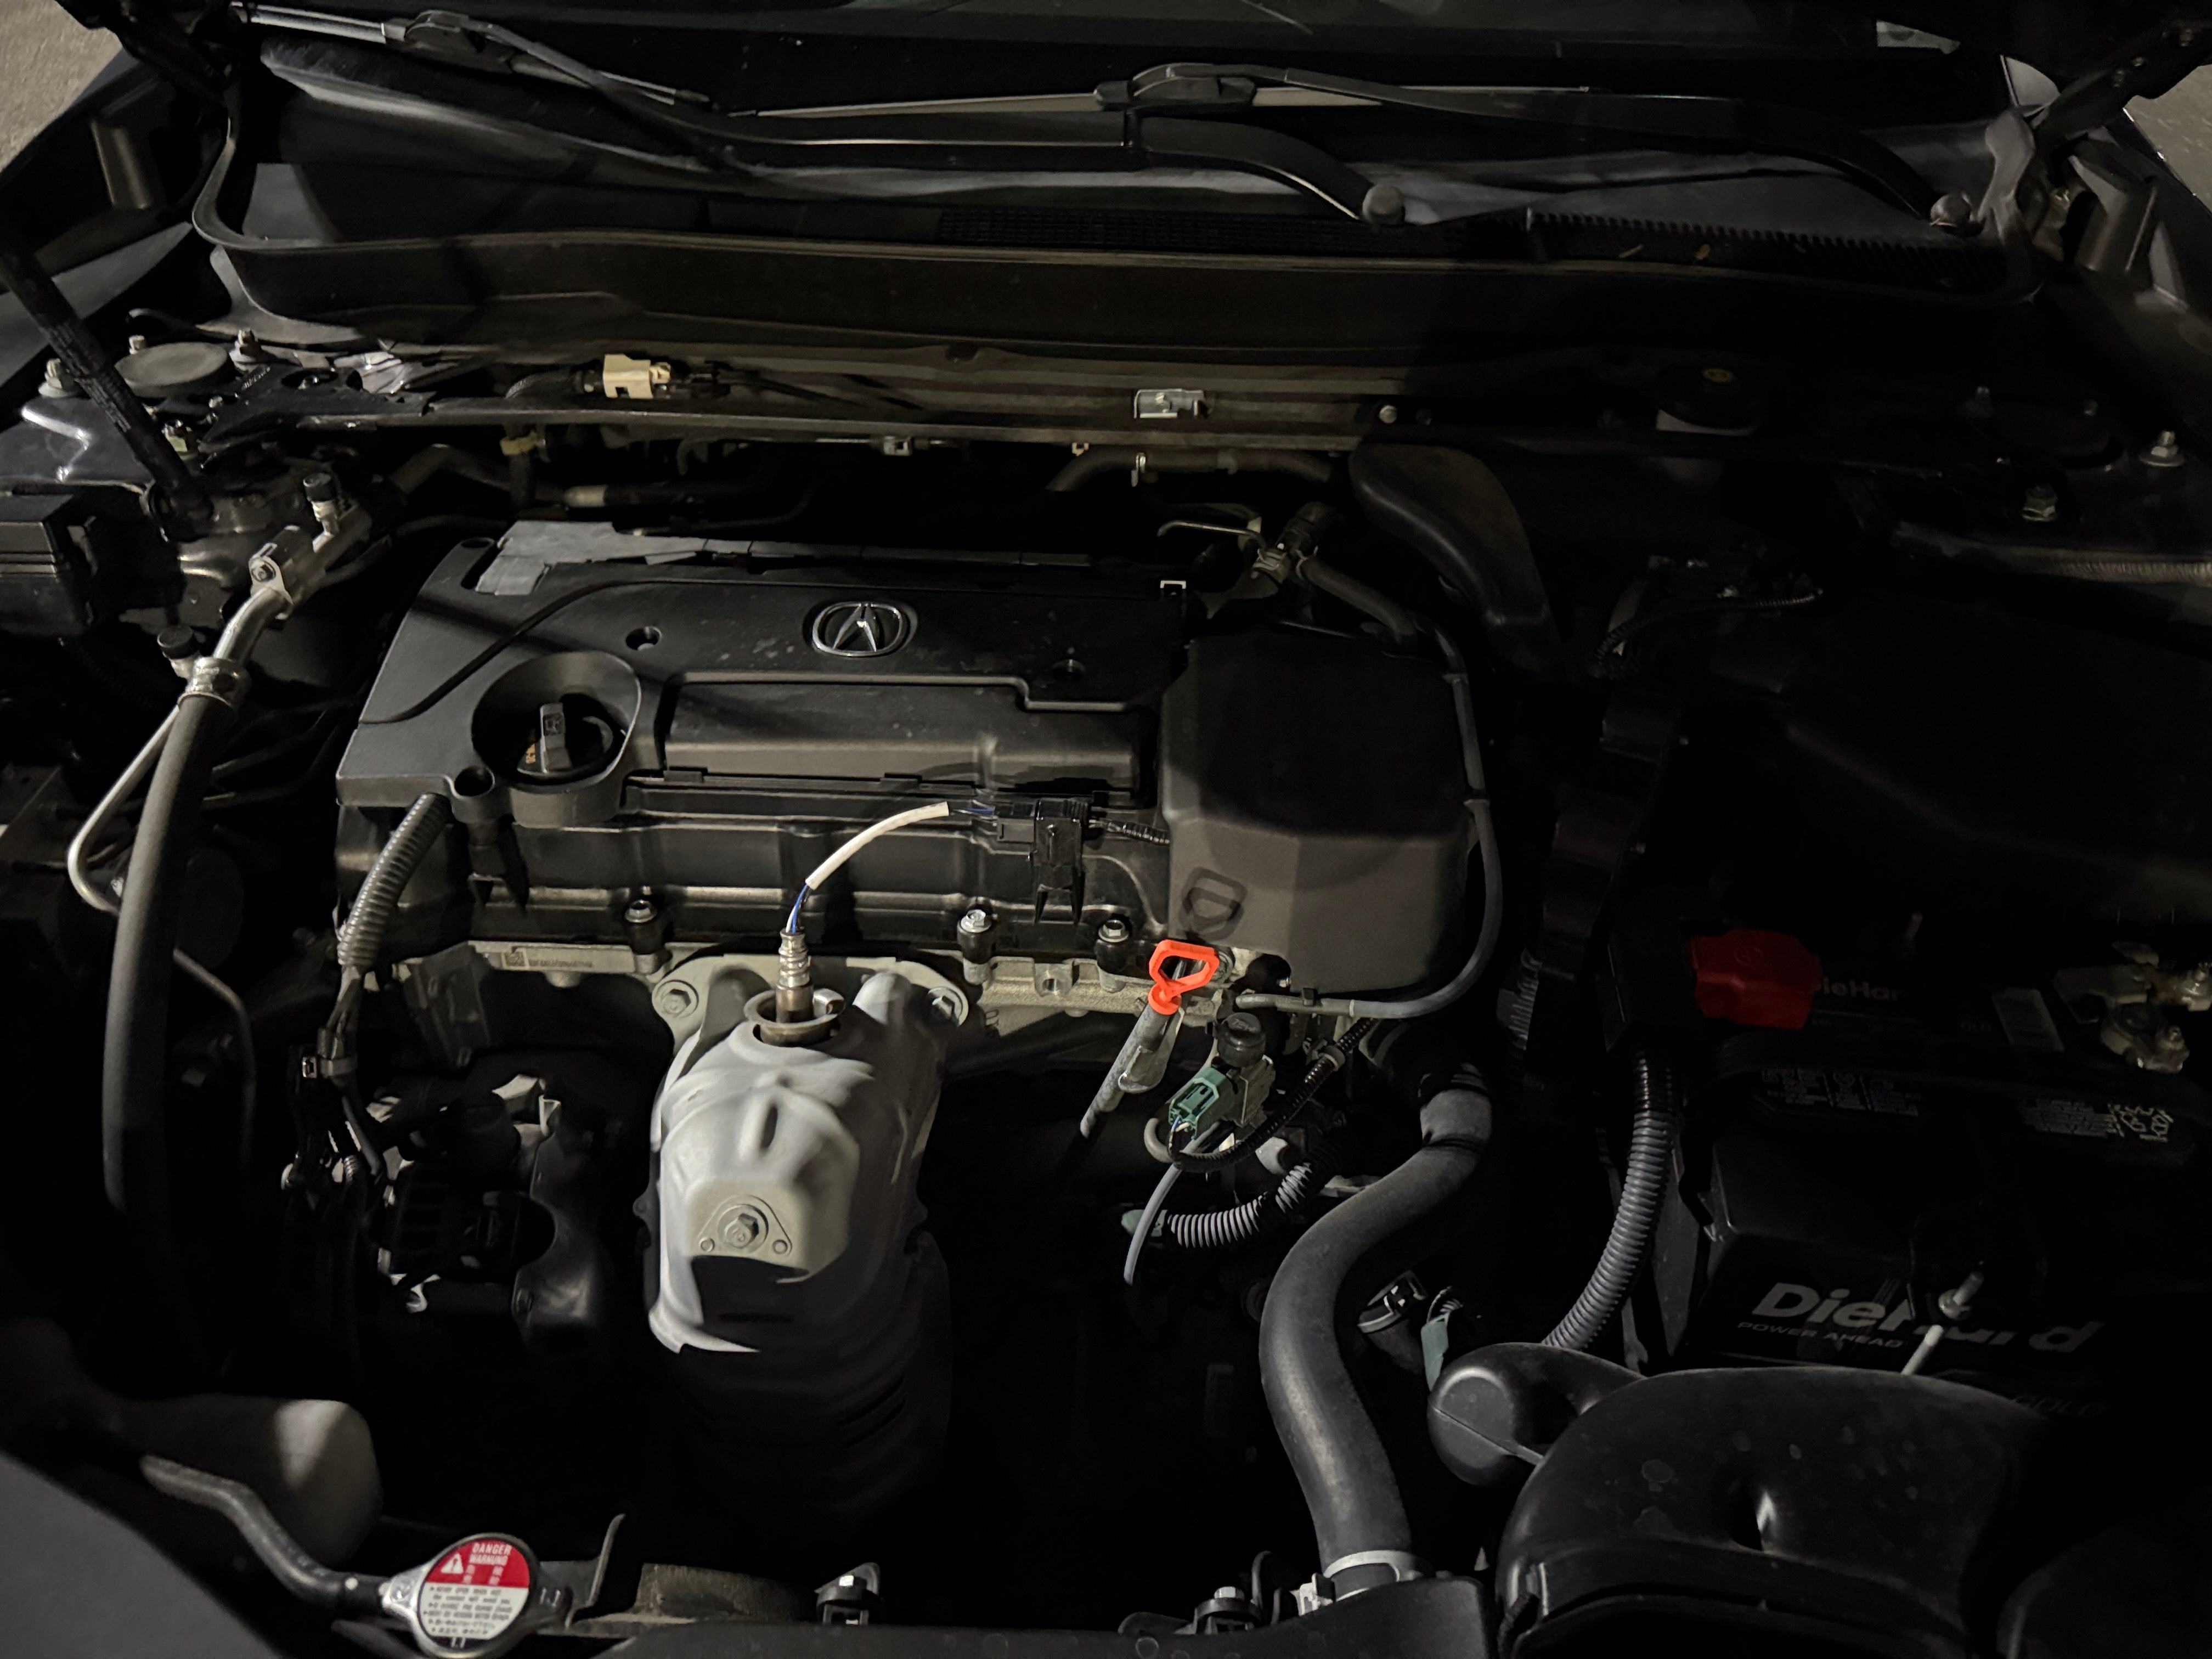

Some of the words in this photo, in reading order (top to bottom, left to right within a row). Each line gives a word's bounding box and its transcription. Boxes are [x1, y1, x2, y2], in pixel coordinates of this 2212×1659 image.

[1737, 1321, 1818, 1338] POWER
[1822, 1331, 1903, 1348] AHEAD
[472, 1543, 512, 1555] DANGER
